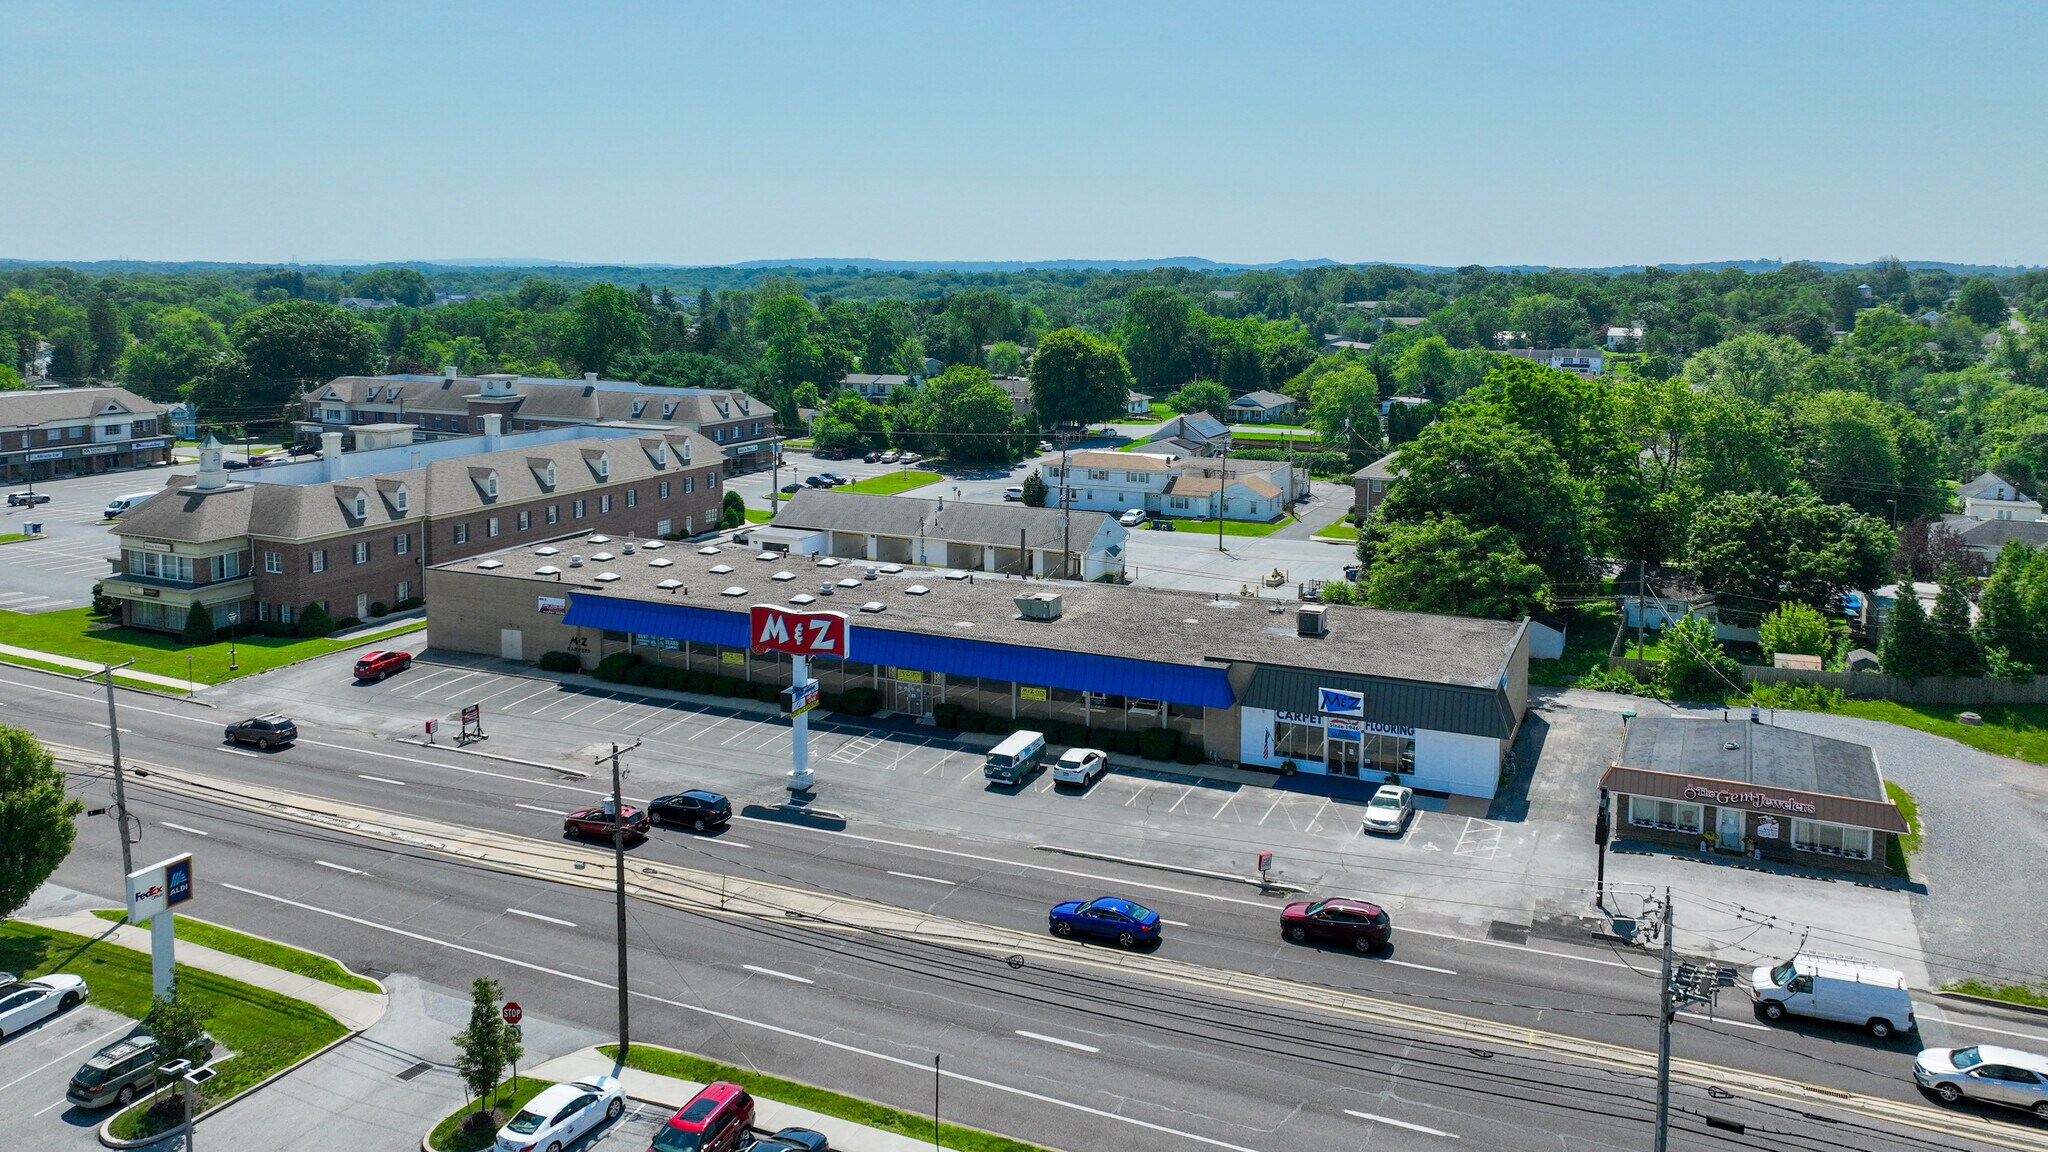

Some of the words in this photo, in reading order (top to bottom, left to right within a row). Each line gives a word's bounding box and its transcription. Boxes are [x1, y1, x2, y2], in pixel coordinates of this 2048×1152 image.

[1320, 693, 1361, 710] M&Z
[1276, 711, 1323, 724] CARPET
[1329, 722, 1345, 730] Since
[1365, 722, 1415, 736] FLOORING
[1697, 786, 1716, 798] The
[1716, 790, 1753, 804] Gem
[1752, 793, 1816, 814] Jewelers
[135, 885, 163, 902] FedEx
[170, 883, 189, 896] ALDI
[503, 1008, 521, 1018] STOP
